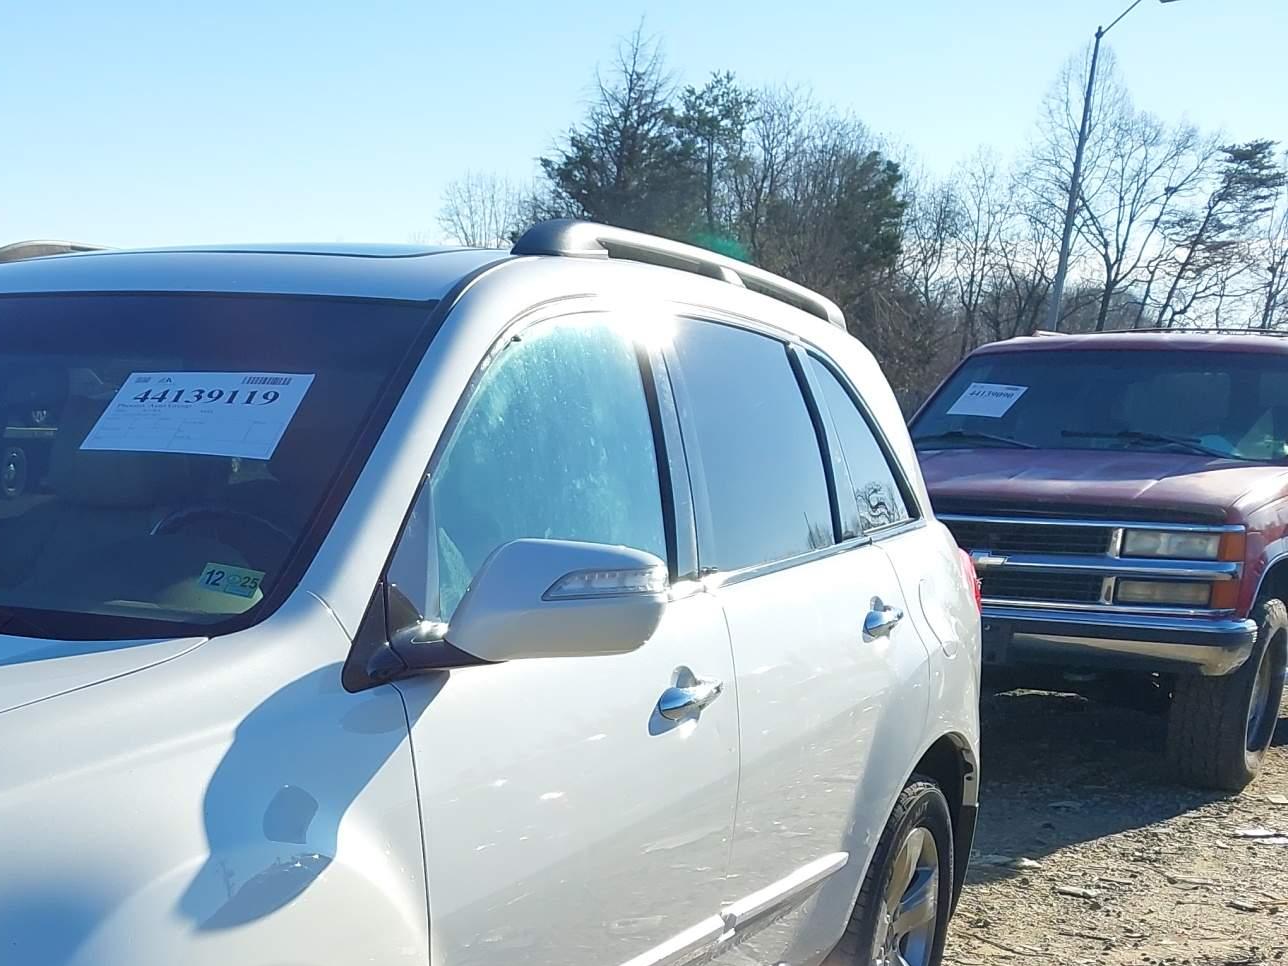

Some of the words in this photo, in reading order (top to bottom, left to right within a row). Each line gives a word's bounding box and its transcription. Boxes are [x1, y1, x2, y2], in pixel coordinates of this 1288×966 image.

[133, 388, 280, 406] 44139119
[205, 569, 225, 586] 12
[240, 576, 259, 589] 25
